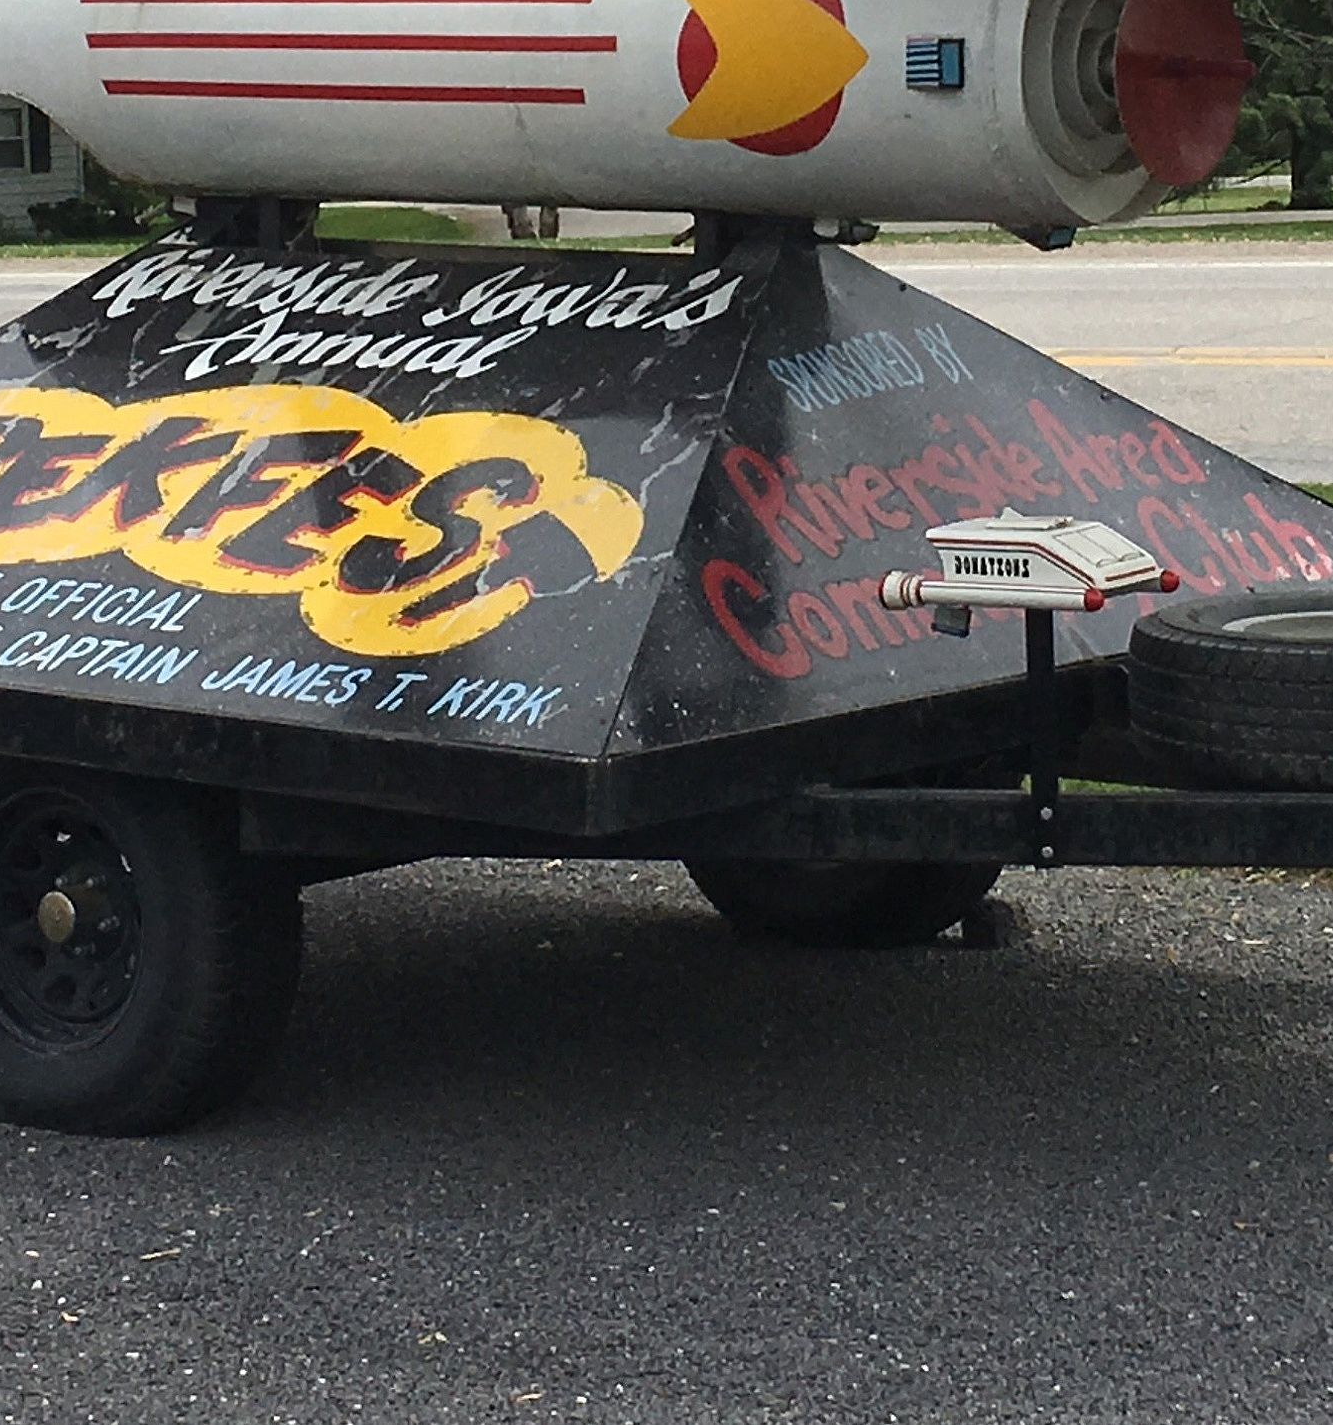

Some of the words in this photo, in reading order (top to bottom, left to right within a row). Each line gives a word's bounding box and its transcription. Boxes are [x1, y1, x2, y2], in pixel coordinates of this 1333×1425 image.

[93, 248, 438, 319] Riverside
[421, 265, 744, 332] Iowa's
[160, 308, 538, 381] Annual
[767, 329, 925, 413] SPONSORED
[914, 323, 975, 384] BY
[721, 413, 1062, 564] Riverside
[1028, 399, 1207, 503] Area
[953, 554, 1031, 579] DONATIONS
[0, 576, 204, 632] OFFICIAL
[200, 655, 373, 707] JAMES
[426, 676, 564, 727] KIRK
